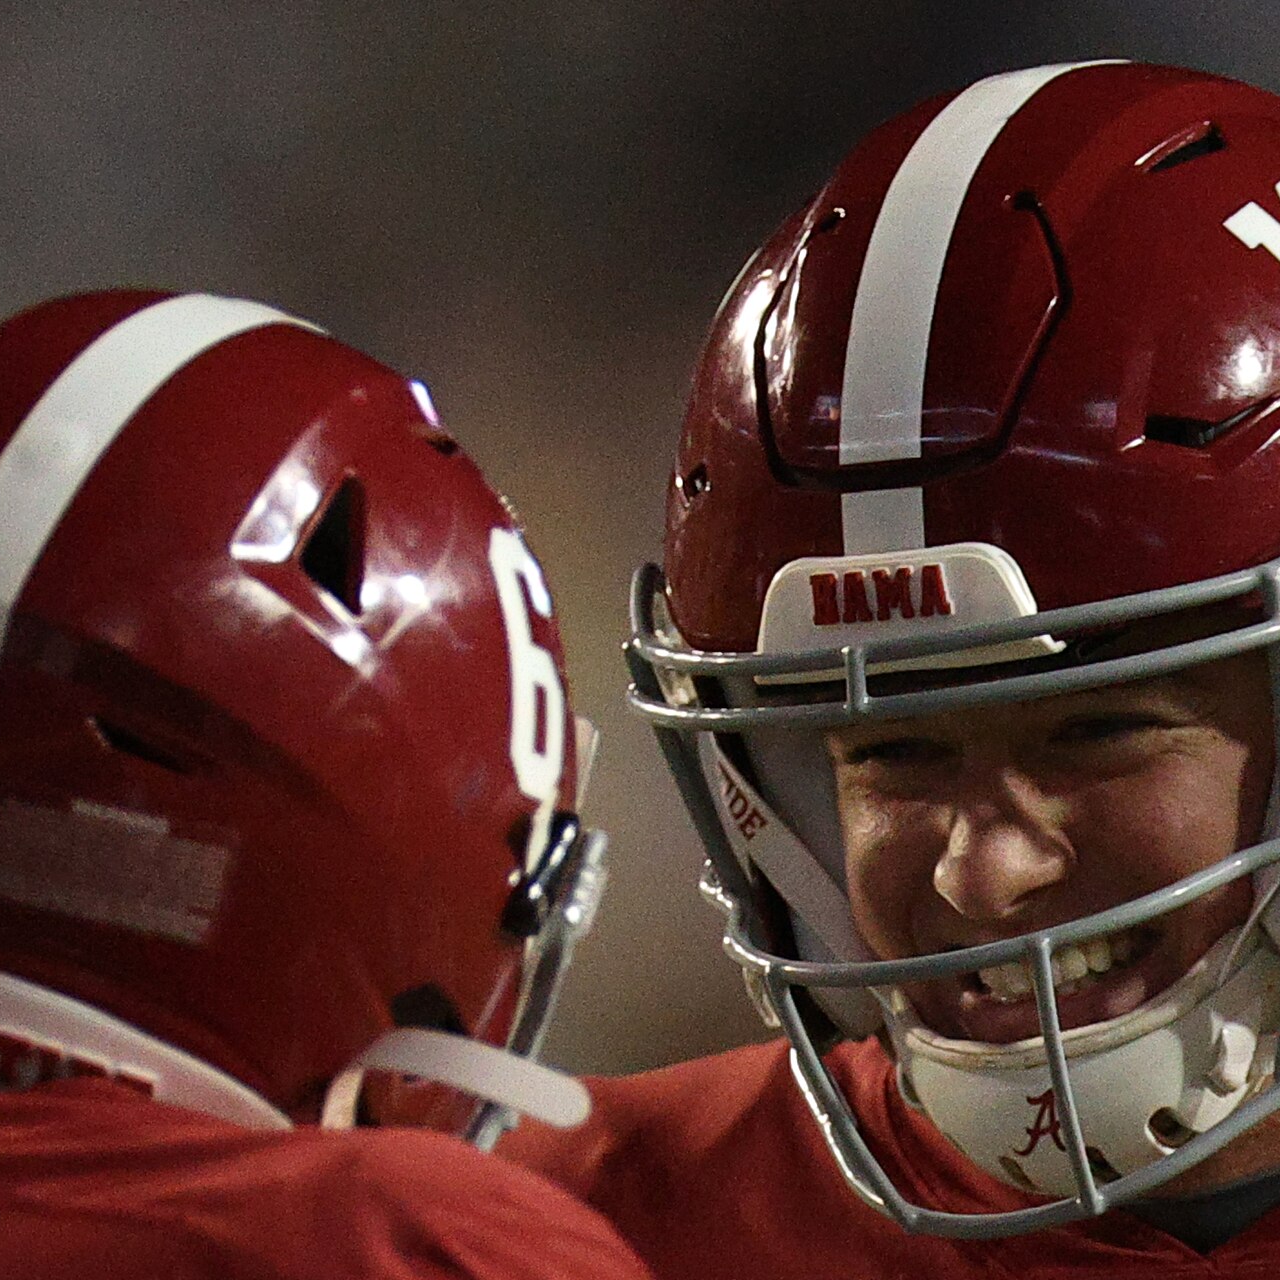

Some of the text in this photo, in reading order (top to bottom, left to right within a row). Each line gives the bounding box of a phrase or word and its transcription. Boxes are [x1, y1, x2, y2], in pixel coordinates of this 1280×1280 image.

[809, 563, 957, 627] BAMA
[488, 527, 565, 801] 6
[1012, 1087, 1067, 1157] A
